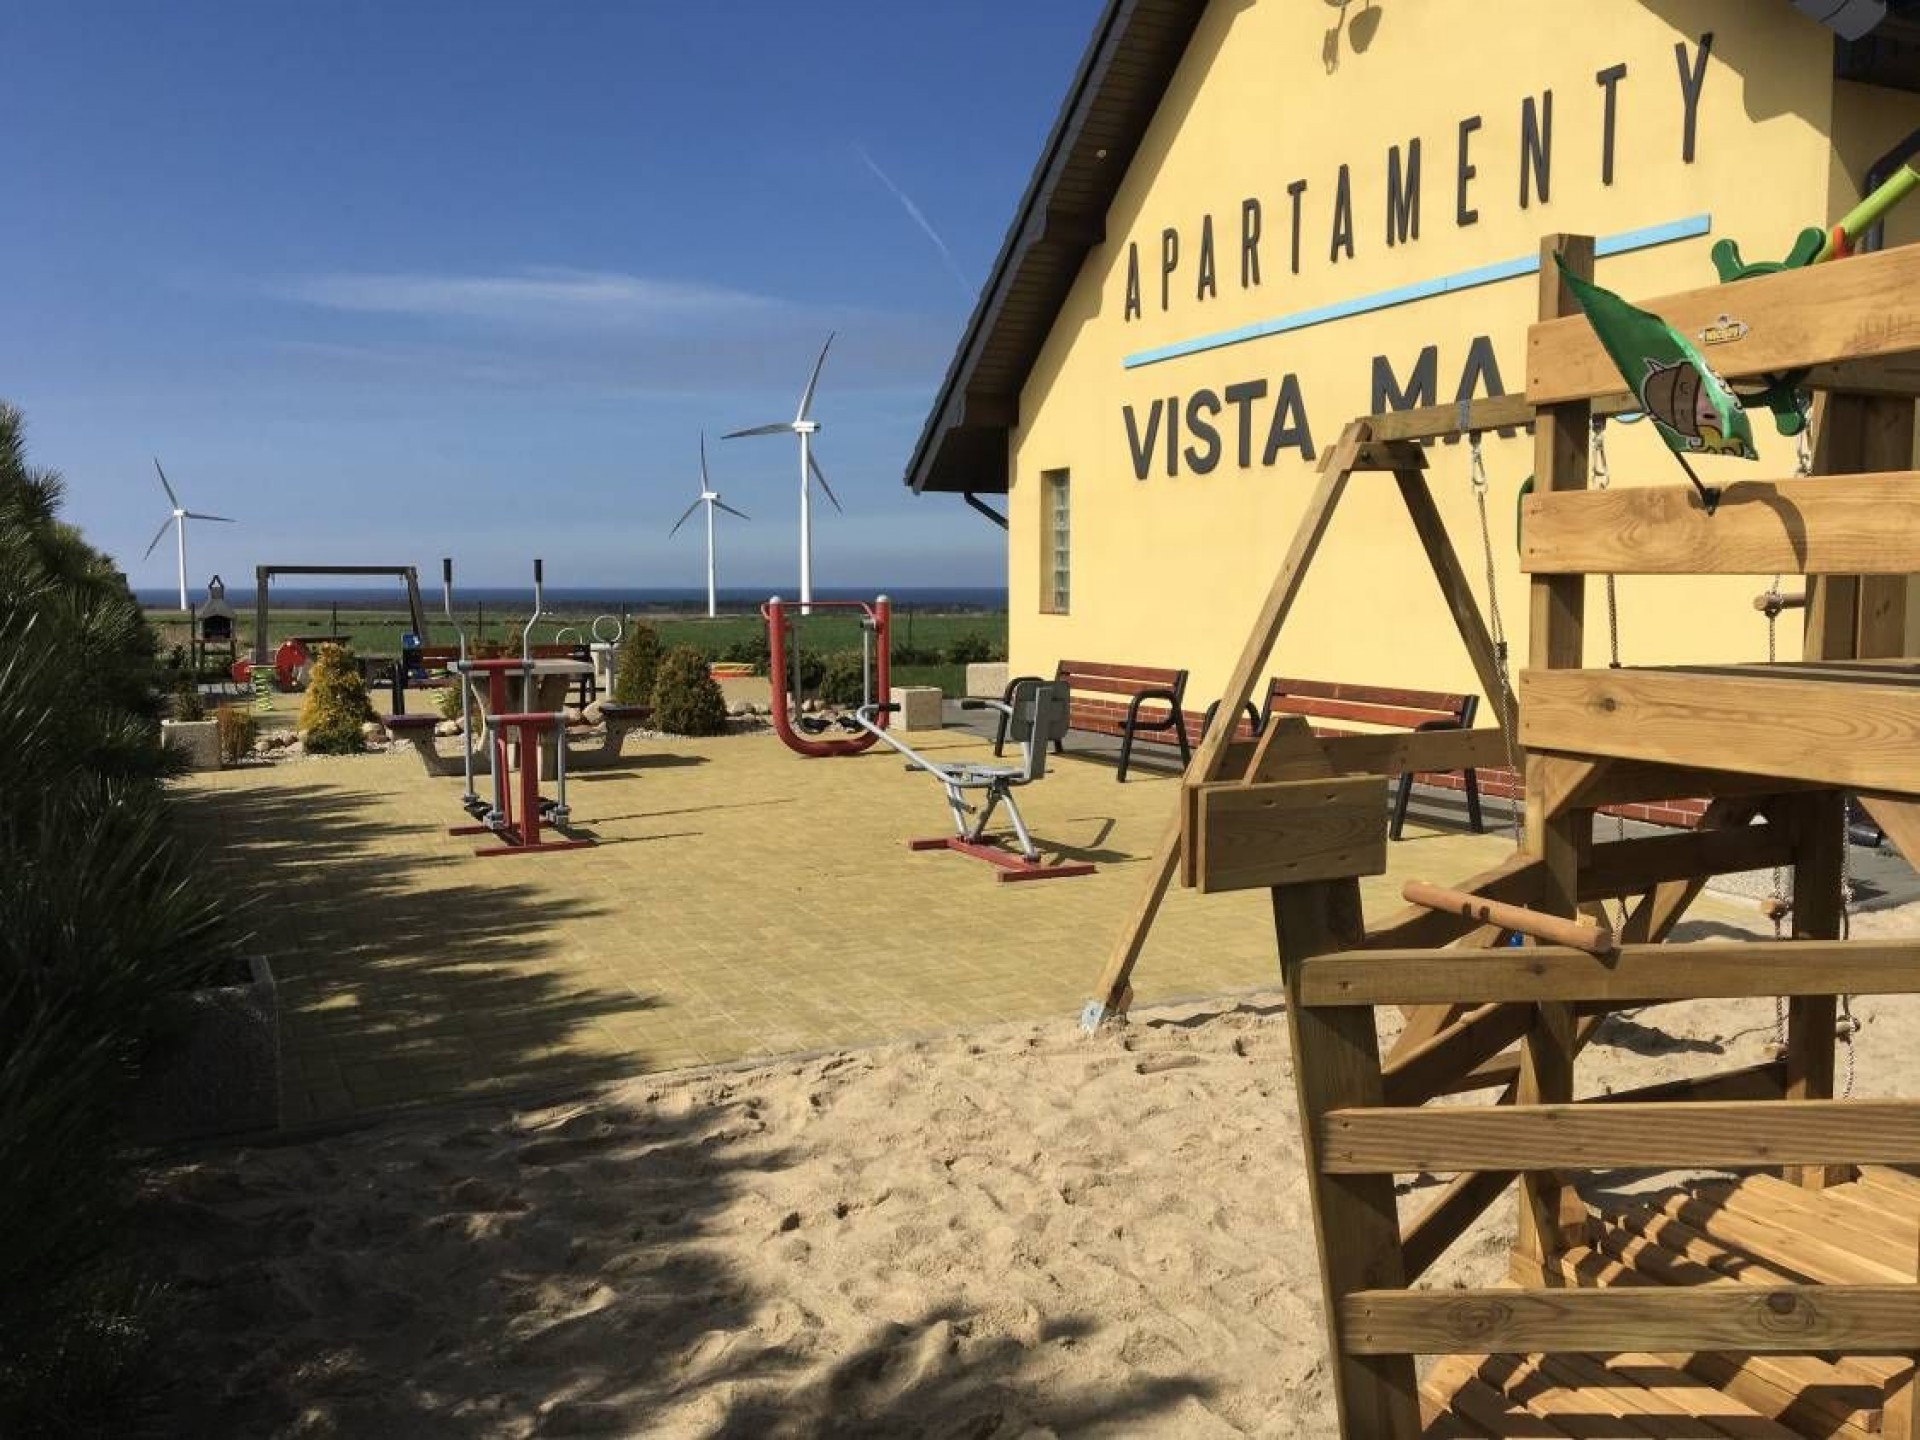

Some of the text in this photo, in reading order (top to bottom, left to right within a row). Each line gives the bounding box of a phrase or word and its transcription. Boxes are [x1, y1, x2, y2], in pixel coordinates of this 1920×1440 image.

[1124, 32, 1712, 322] APARTAMENTY
[1122, 336, 1537, 480] VISTA MA
